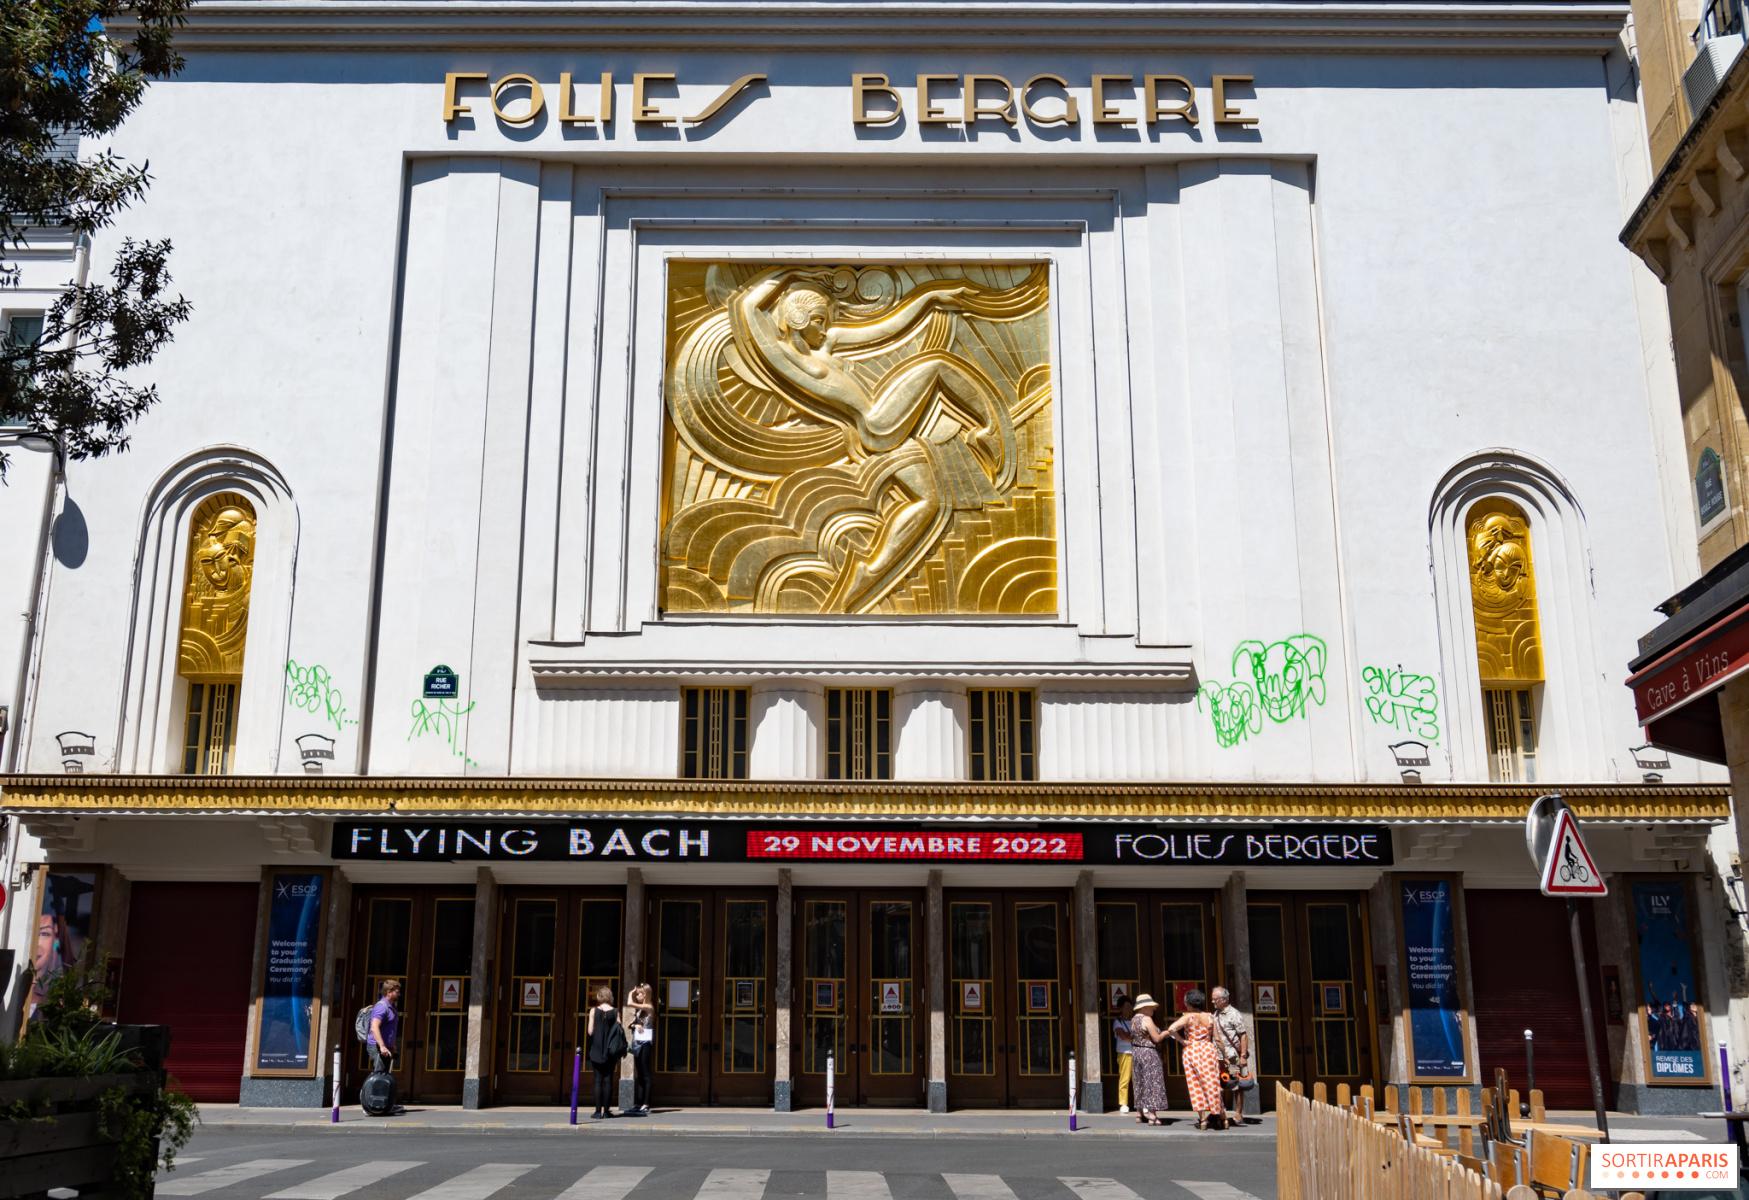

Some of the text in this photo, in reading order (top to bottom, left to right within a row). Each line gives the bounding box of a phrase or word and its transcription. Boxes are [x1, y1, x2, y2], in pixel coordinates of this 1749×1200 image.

[443, 72, 1260, 126] FOLIES BERGERE
[1647, 651, 1729, 710] Cave à Vins
[351, 828, 709, 856] FLYING BACH
[763, 836, 1067, 854] 29 NOVEMBRE 2022
[1115, 834, 1379, 859] FOLIES BERGERE
[291, 885, 318, 894] ESCP
[1419, 891, 1445, 900] ESCP
[281, 949, 298, 957] your
[270, 957, 313, 965] Graduation
[269, 966, 309, 975] Ceremony
[1410, 963, 1453, 971] Graduation
[1411, 972, 1450, 980] Ceremony
[1656, 1061, 1694, 1074] DIPLÔMES
